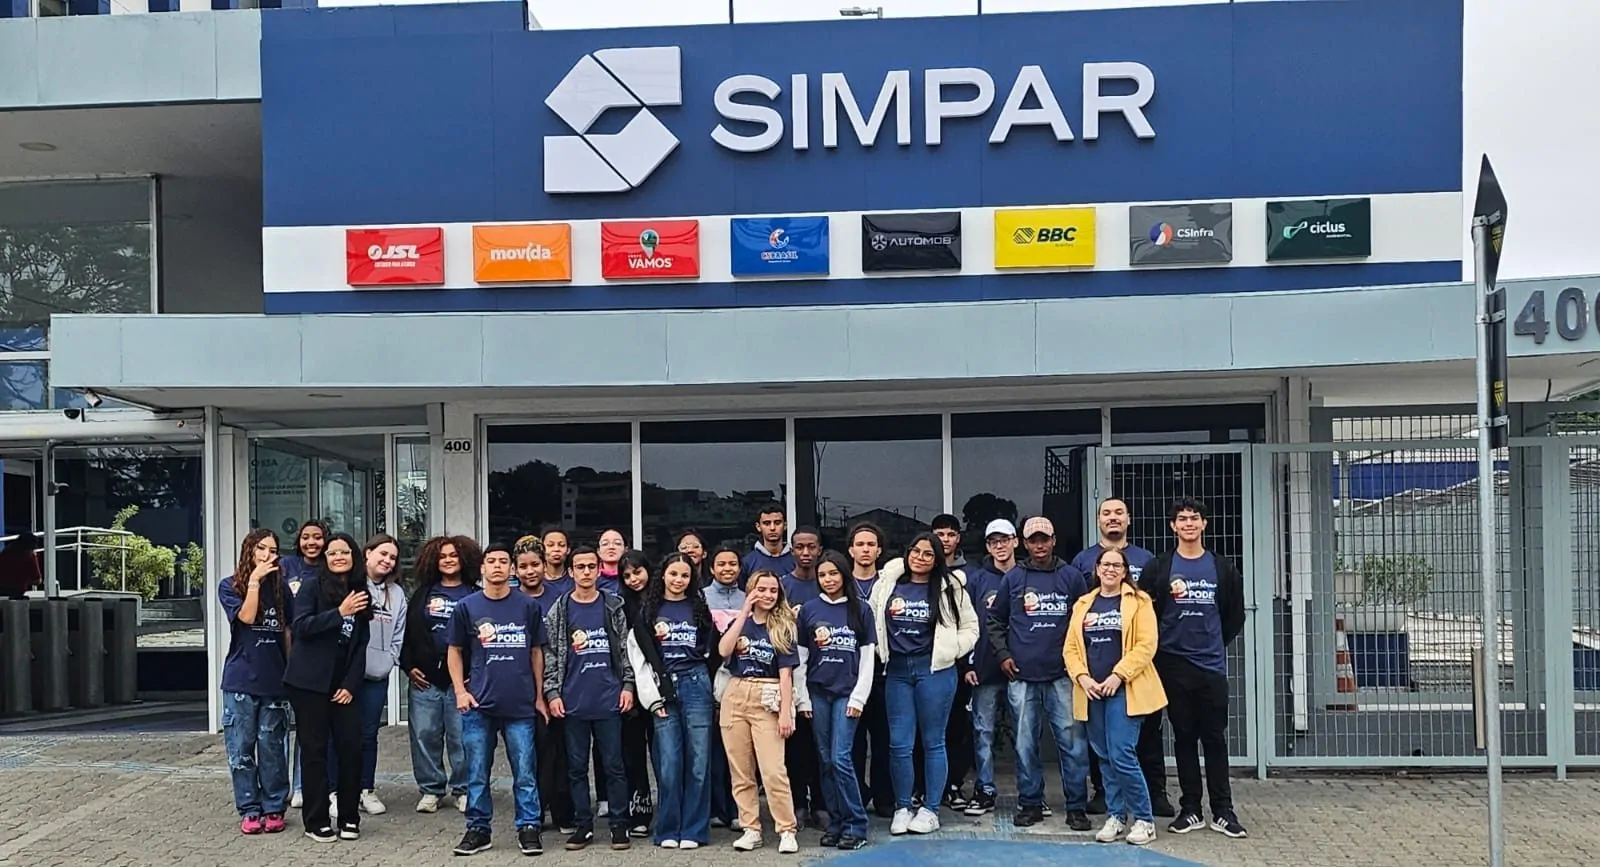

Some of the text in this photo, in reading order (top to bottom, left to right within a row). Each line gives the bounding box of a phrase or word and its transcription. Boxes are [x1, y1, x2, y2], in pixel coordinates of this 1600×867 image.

[710, 61, 1156, 153] SIMPAR
[1177, 228, 1214, 238] CSInfra
[1310, 221, 1346, 234] ciclus
[1037, 227, 1077, 242] BBC
[889, 236, 952, 247] AUTOMOB
[381, 245, 420, 259] JSL
[490, 242, 551, 261] movida
[628, 257, 672, 269] VAMOS
[1514, 287, 1600, 345] 40
[444, 440, 471, 452] 400
